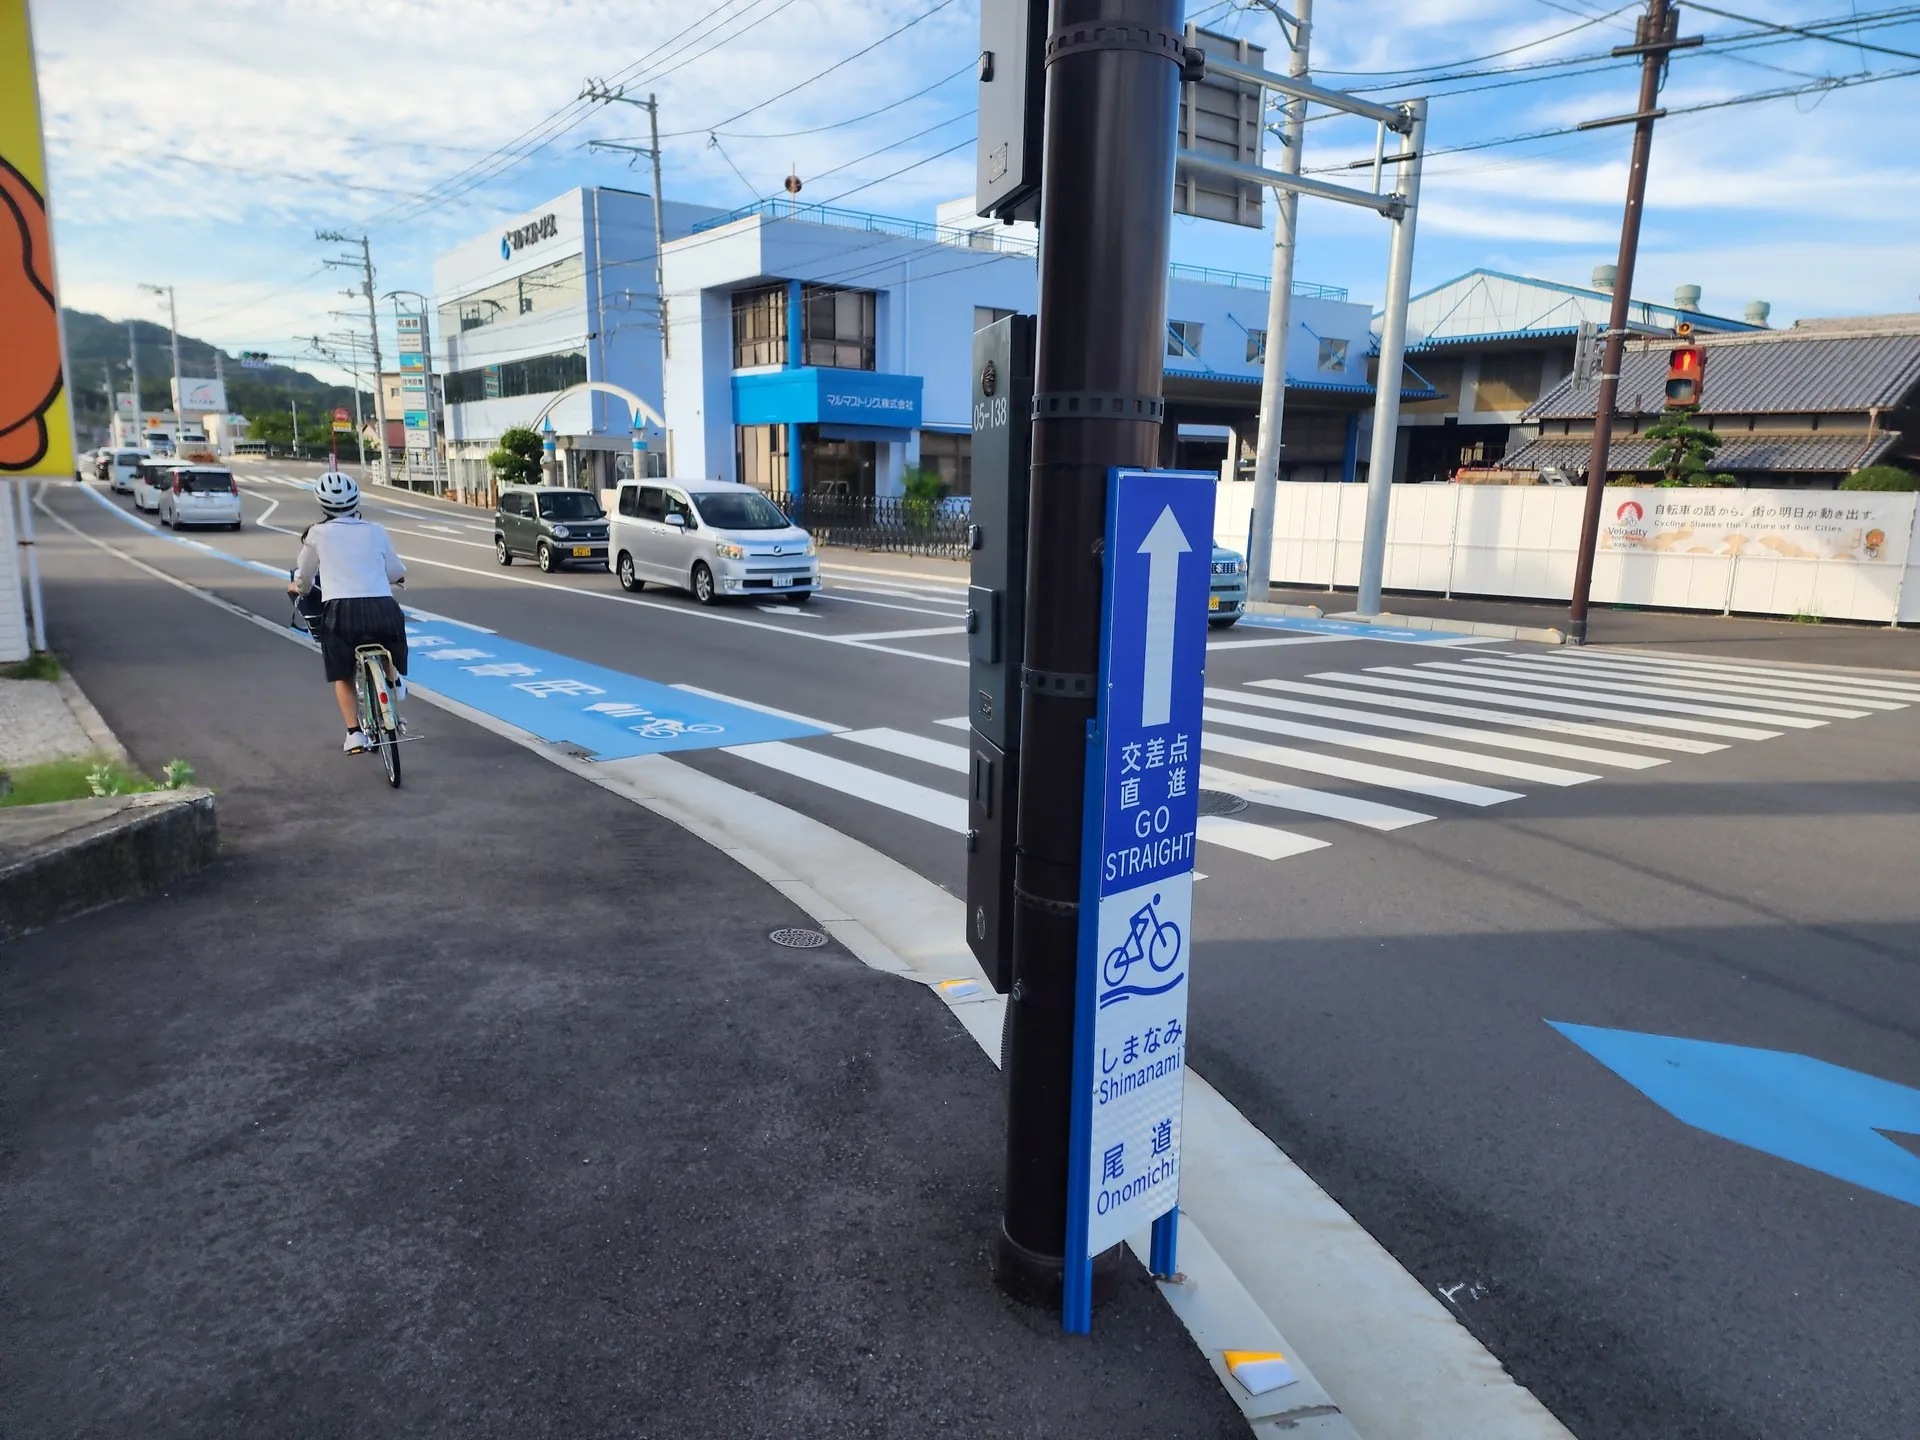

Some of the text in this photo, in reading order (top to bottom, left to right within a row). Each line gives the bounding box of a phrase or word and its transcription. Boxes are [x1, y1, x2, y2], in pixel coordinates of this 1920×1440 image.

[974, 396, 1007, 432] 05-138
[1608, 526, 1648, 537] Velo-city
[1654, 519, 1686, 528] Cycling
[1690, 520, 1722, 528] Shapes
[1726, 521, 1741, 529] the
[1744, 521, 1776, 530] Future
[1794, 523, 1810, 531] Our
[1655, 504, 1876, 521] 自転車の話から、街の明日が動き出す。
[1121, 733, 1189, 775] 交差点
[1135, 805, 1170, 839] GO
[1105, 831, 1194, 881] STRAIGHT
[1102, 1018, 1183, 1075] しまなみ
[1099, 1047, 1180, 1105] Shimanami
[1097, 1153, 1174, 1215] Onomichi
